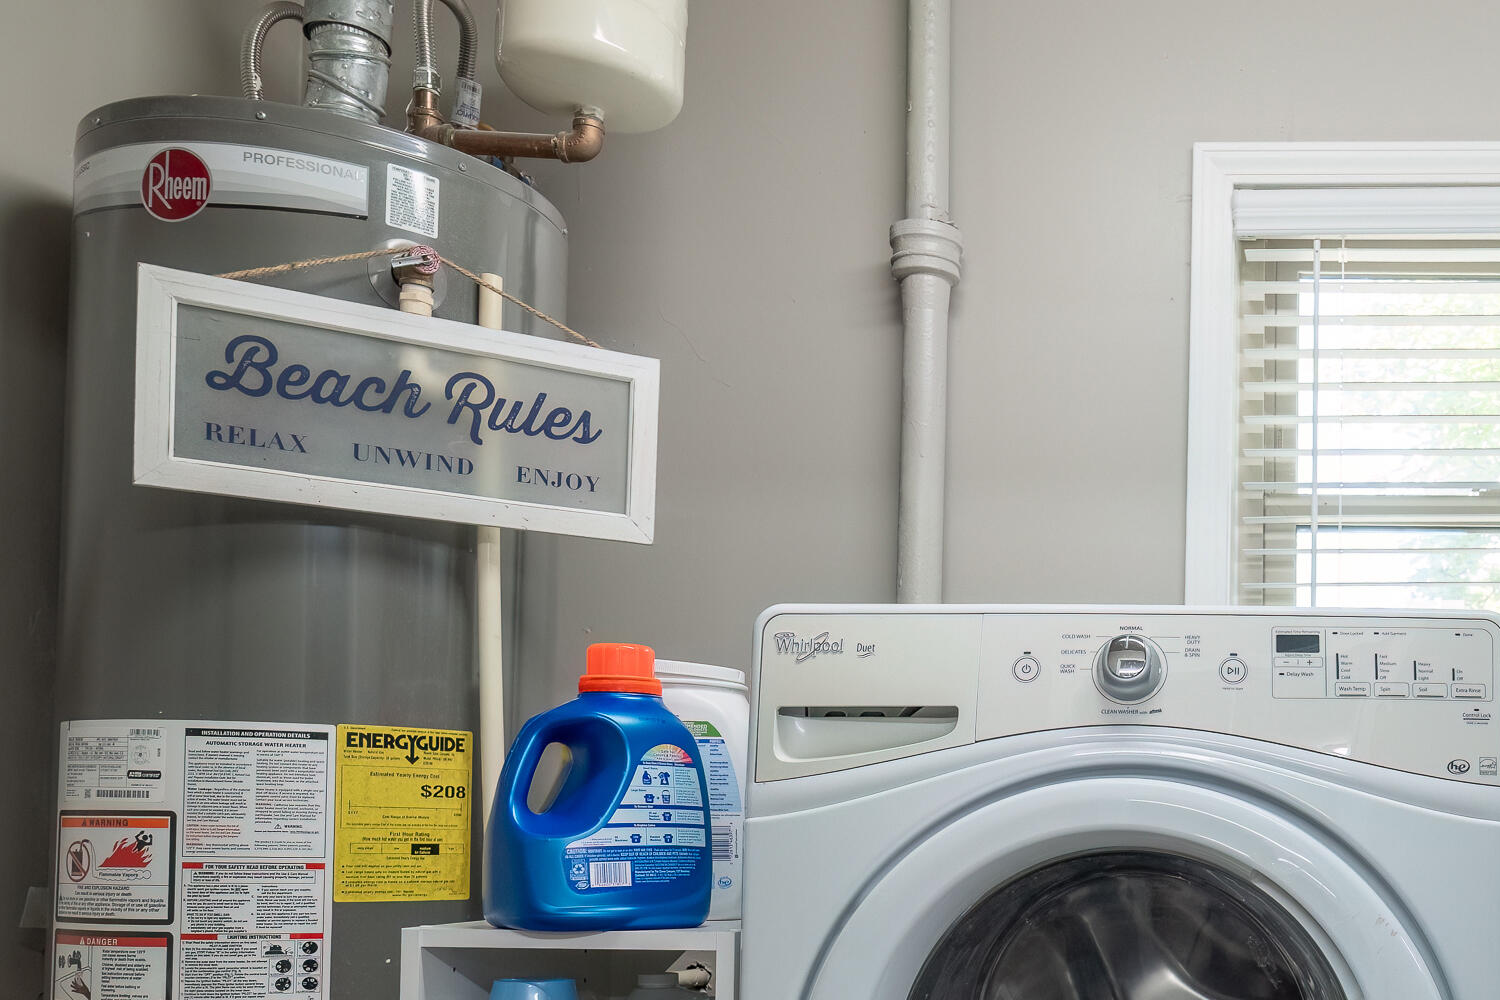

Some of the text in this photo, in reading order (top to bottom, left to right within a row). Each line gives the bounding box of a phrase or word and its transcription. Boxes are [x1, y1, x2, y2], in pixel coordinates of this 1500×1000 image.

[242, 151, 364, 184] PROFESSIONAL
[149, 150, 208, 210] Rheem
[204, 333, 602, 446] Beach Rules
[203, 421, 601, 494] RELAX UNWIND ENJOY
[774, 636, 845, 659] Whirlpool
[856, 642, 876, 654] Duet
[346, 731, 466, 757] ENERGYGUIDE
[1449, 760, 1468, 774] he
[420, 784, 466, 800] $208
[89, 818, 129, 827] WARNING
[86, 938, 118, 946] DANGER
